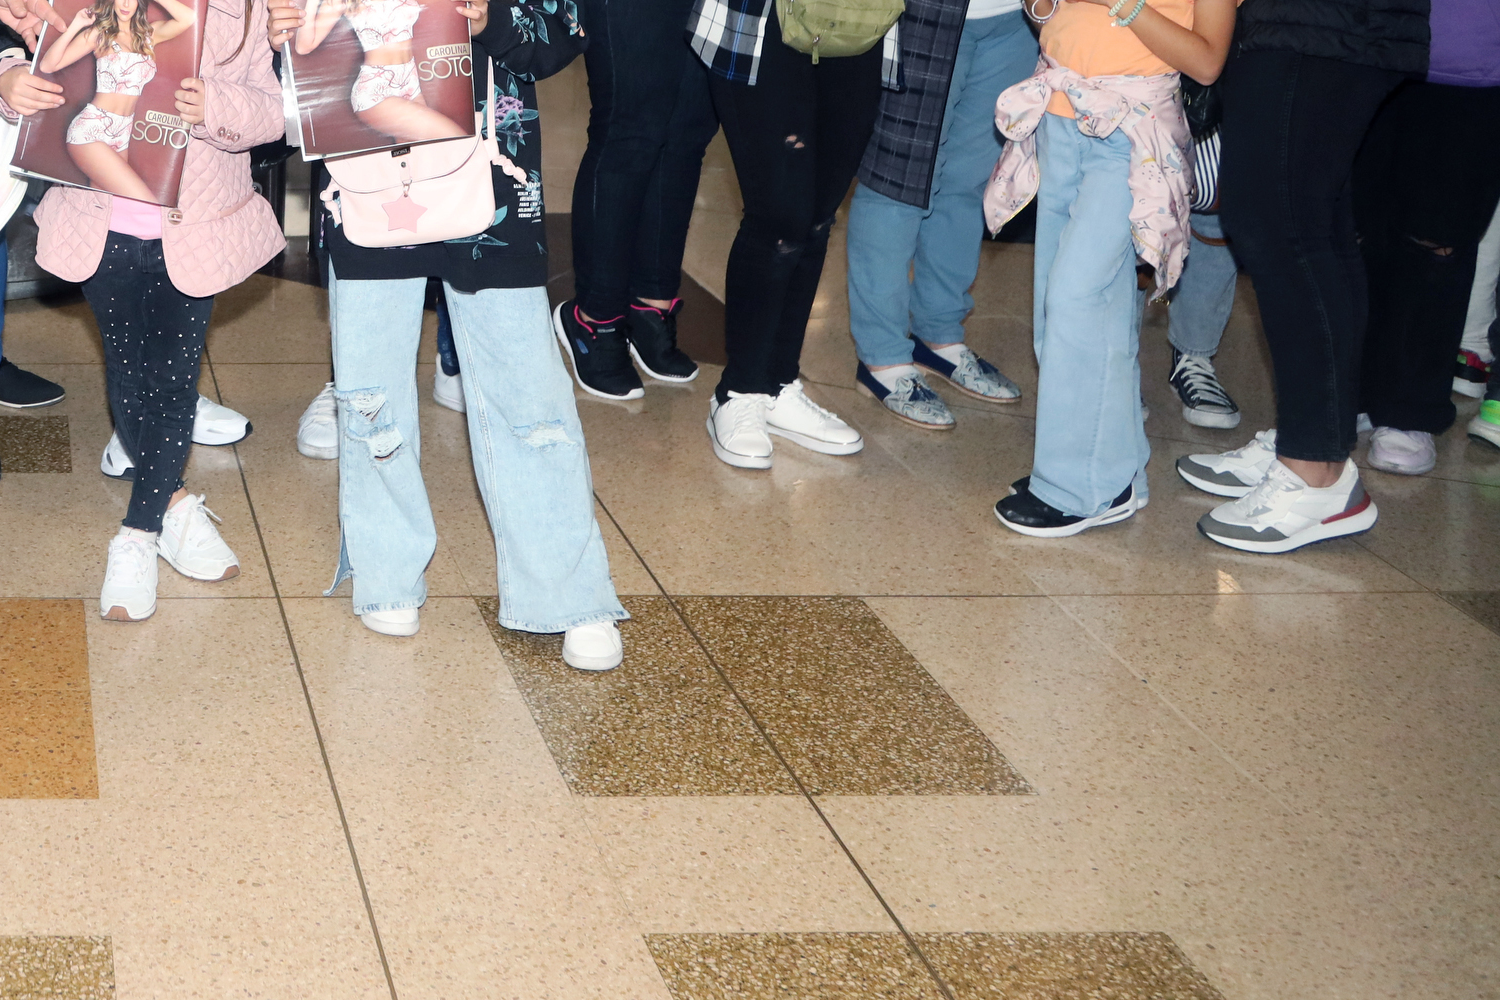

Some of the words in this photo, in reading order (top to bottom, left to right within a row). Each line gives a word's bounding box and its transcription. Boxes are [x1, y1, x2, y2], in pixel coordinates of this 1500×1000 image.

[429, 45, 468, 58] CAROLINA
[419, 56, 472, 81] SOTO
[147, 112, 183, 127] CAROLINA
[132, 121, 188, 149] SOTO
